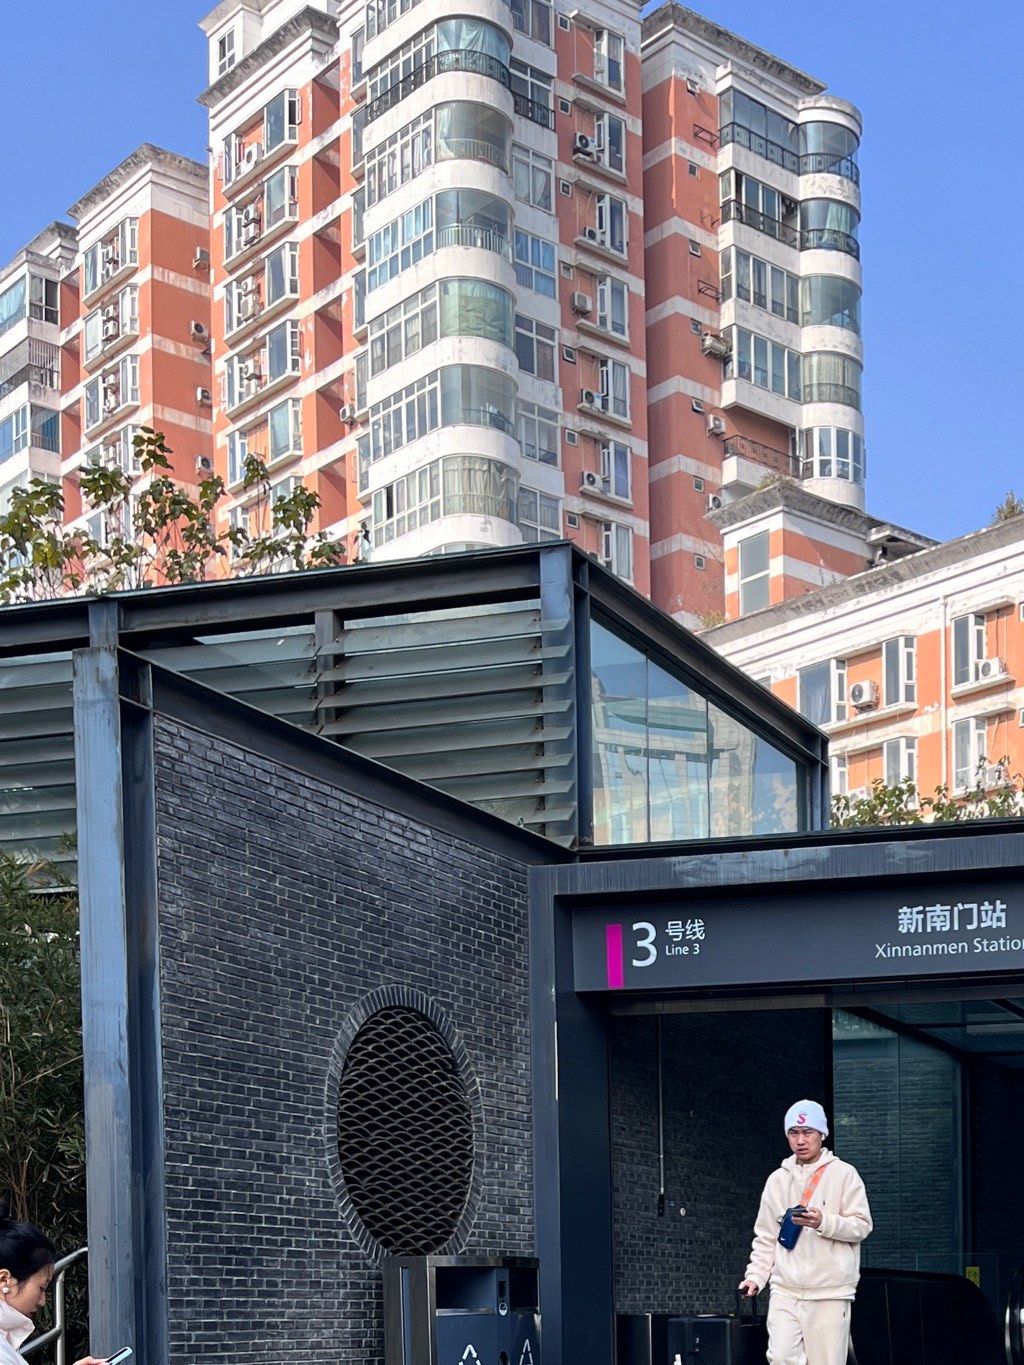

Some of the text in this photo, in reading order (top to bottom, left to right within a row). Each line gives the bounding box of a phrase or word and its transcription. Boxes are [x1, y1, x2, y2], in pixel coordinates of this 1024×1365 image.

[898, 900, 1007, 934] 新南门站
[665, 918, 706, 942] 号线
[632, 921, 658, 968] 3
[665, 943, 700, 956] Line 3
[875, 942, 968, 959] Xinnanmen
[797, 1113, 807, 1124] S
